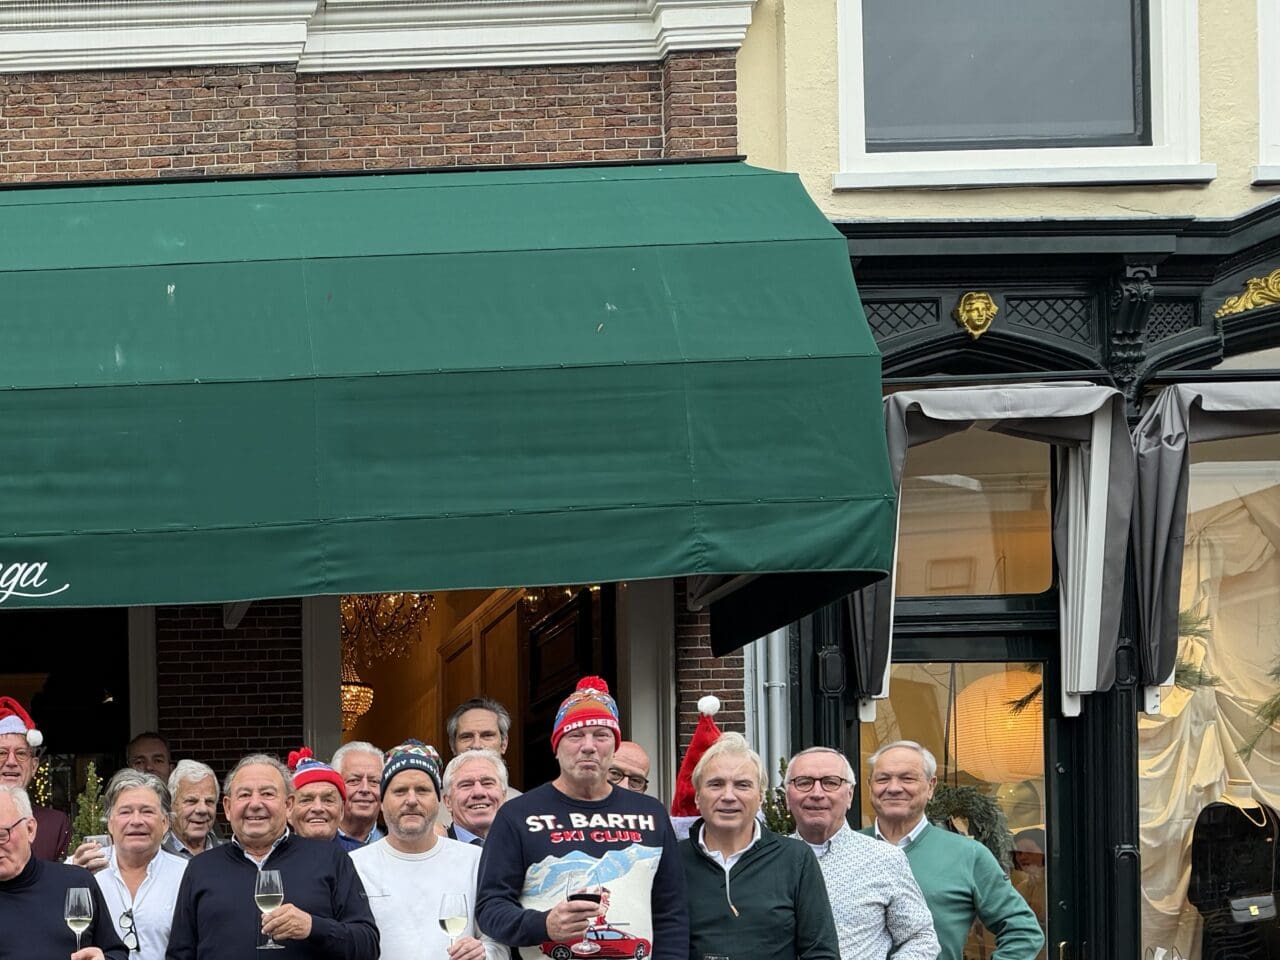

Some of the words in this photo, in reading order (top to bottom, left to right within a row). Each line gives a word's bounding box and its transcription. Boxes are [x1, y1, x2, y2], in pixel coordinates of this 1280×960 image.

[526, 814, 563, 832] ST.
[569, 812, 656, 832] BARTH
[550, 830, 585, 843] SKI
[590, 829, 643, 843] CLUB
